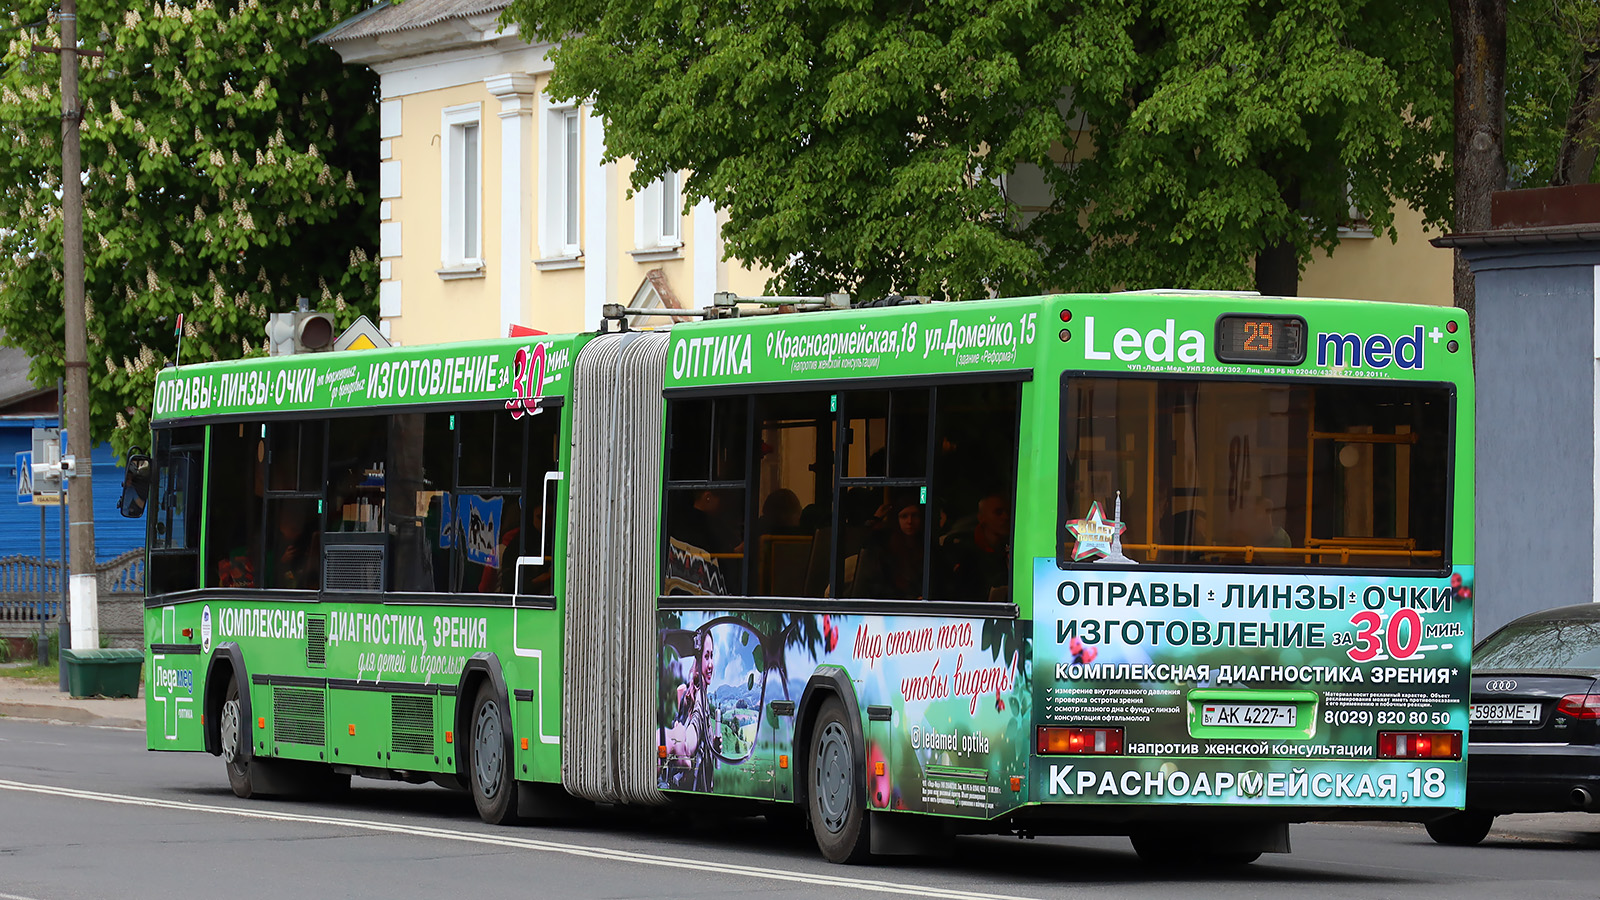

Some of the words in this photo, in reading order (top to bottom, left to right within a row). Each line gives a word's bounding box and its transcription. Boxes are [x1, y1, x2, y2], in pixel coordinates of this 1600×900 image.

[774, 321, 918, 365] Красноармейская,18
[1084, 316, 1205, 363] Leda
[1243, 321, 1273, 351] 29
[672, 333, 752, 380] ОПТИКА
[156, 375, 213, 414] ОПРАВЫ
[217, 371, 270, 407] ЛИНЗЫ
[275, 367, 317, 405] ОЧКИ
[366, 354, 499, 399] ИЗГОТОВЛЕНИЕ
[505, 341, 546, 420] 30
[1077, 520, 1097, 534] 80
[1057, 581, 1200, 608] ОПРАВЫ
[1221, 584, 1345, 610] ЛИНЗЫ
[1362, 586, 1453, 612] ОЧКИ
[218, 607, 305, 639] КОМПЛЕКСНАЯ
[328, 611, 425, 647] ДИАГНОСТИКА
[433, 615, 487, 649] ЗРЕНИЯ
[852, 623, 883, 669] Мир
[885, 625, 935, 658] стоит
[936, 622, 974, 650] того,
[1056, 619, 1326, 648] ИЗГОТОВЛЕНИЕ
[1332, 632, 1353, 646] ЗА
[1346, 608, 1423, 662] 30
[356, 652, 375, 685] для
[376, 650, 406, 685] детей
[411, 655, 418, 674] и
[900, 657, 950, 702] чтобы
[953, 650, 1019, 716] видеть!
[1055, 662, 1210, 682] КОМПЛЕКСНАЯ
[1216, 665, 1364, 684] ДИАГНОСТИКА
[1094, 688, 1148, 696] внутриглазного
[1129, 706, 1155, 714] фундус
[1217, 707, 1240, 723] AK
[1324, 710, 1373, 727] 8(029)
[1376, 711, 1406, 724] 820
[1408, 711, 1428, 725] 80
[1431, 712, 1450, 725] 50
[1128, 742, 1199, 756] напротив
[1204, 741, 1269, 755] женской
[1272, 744, 1373, 757] консультации
